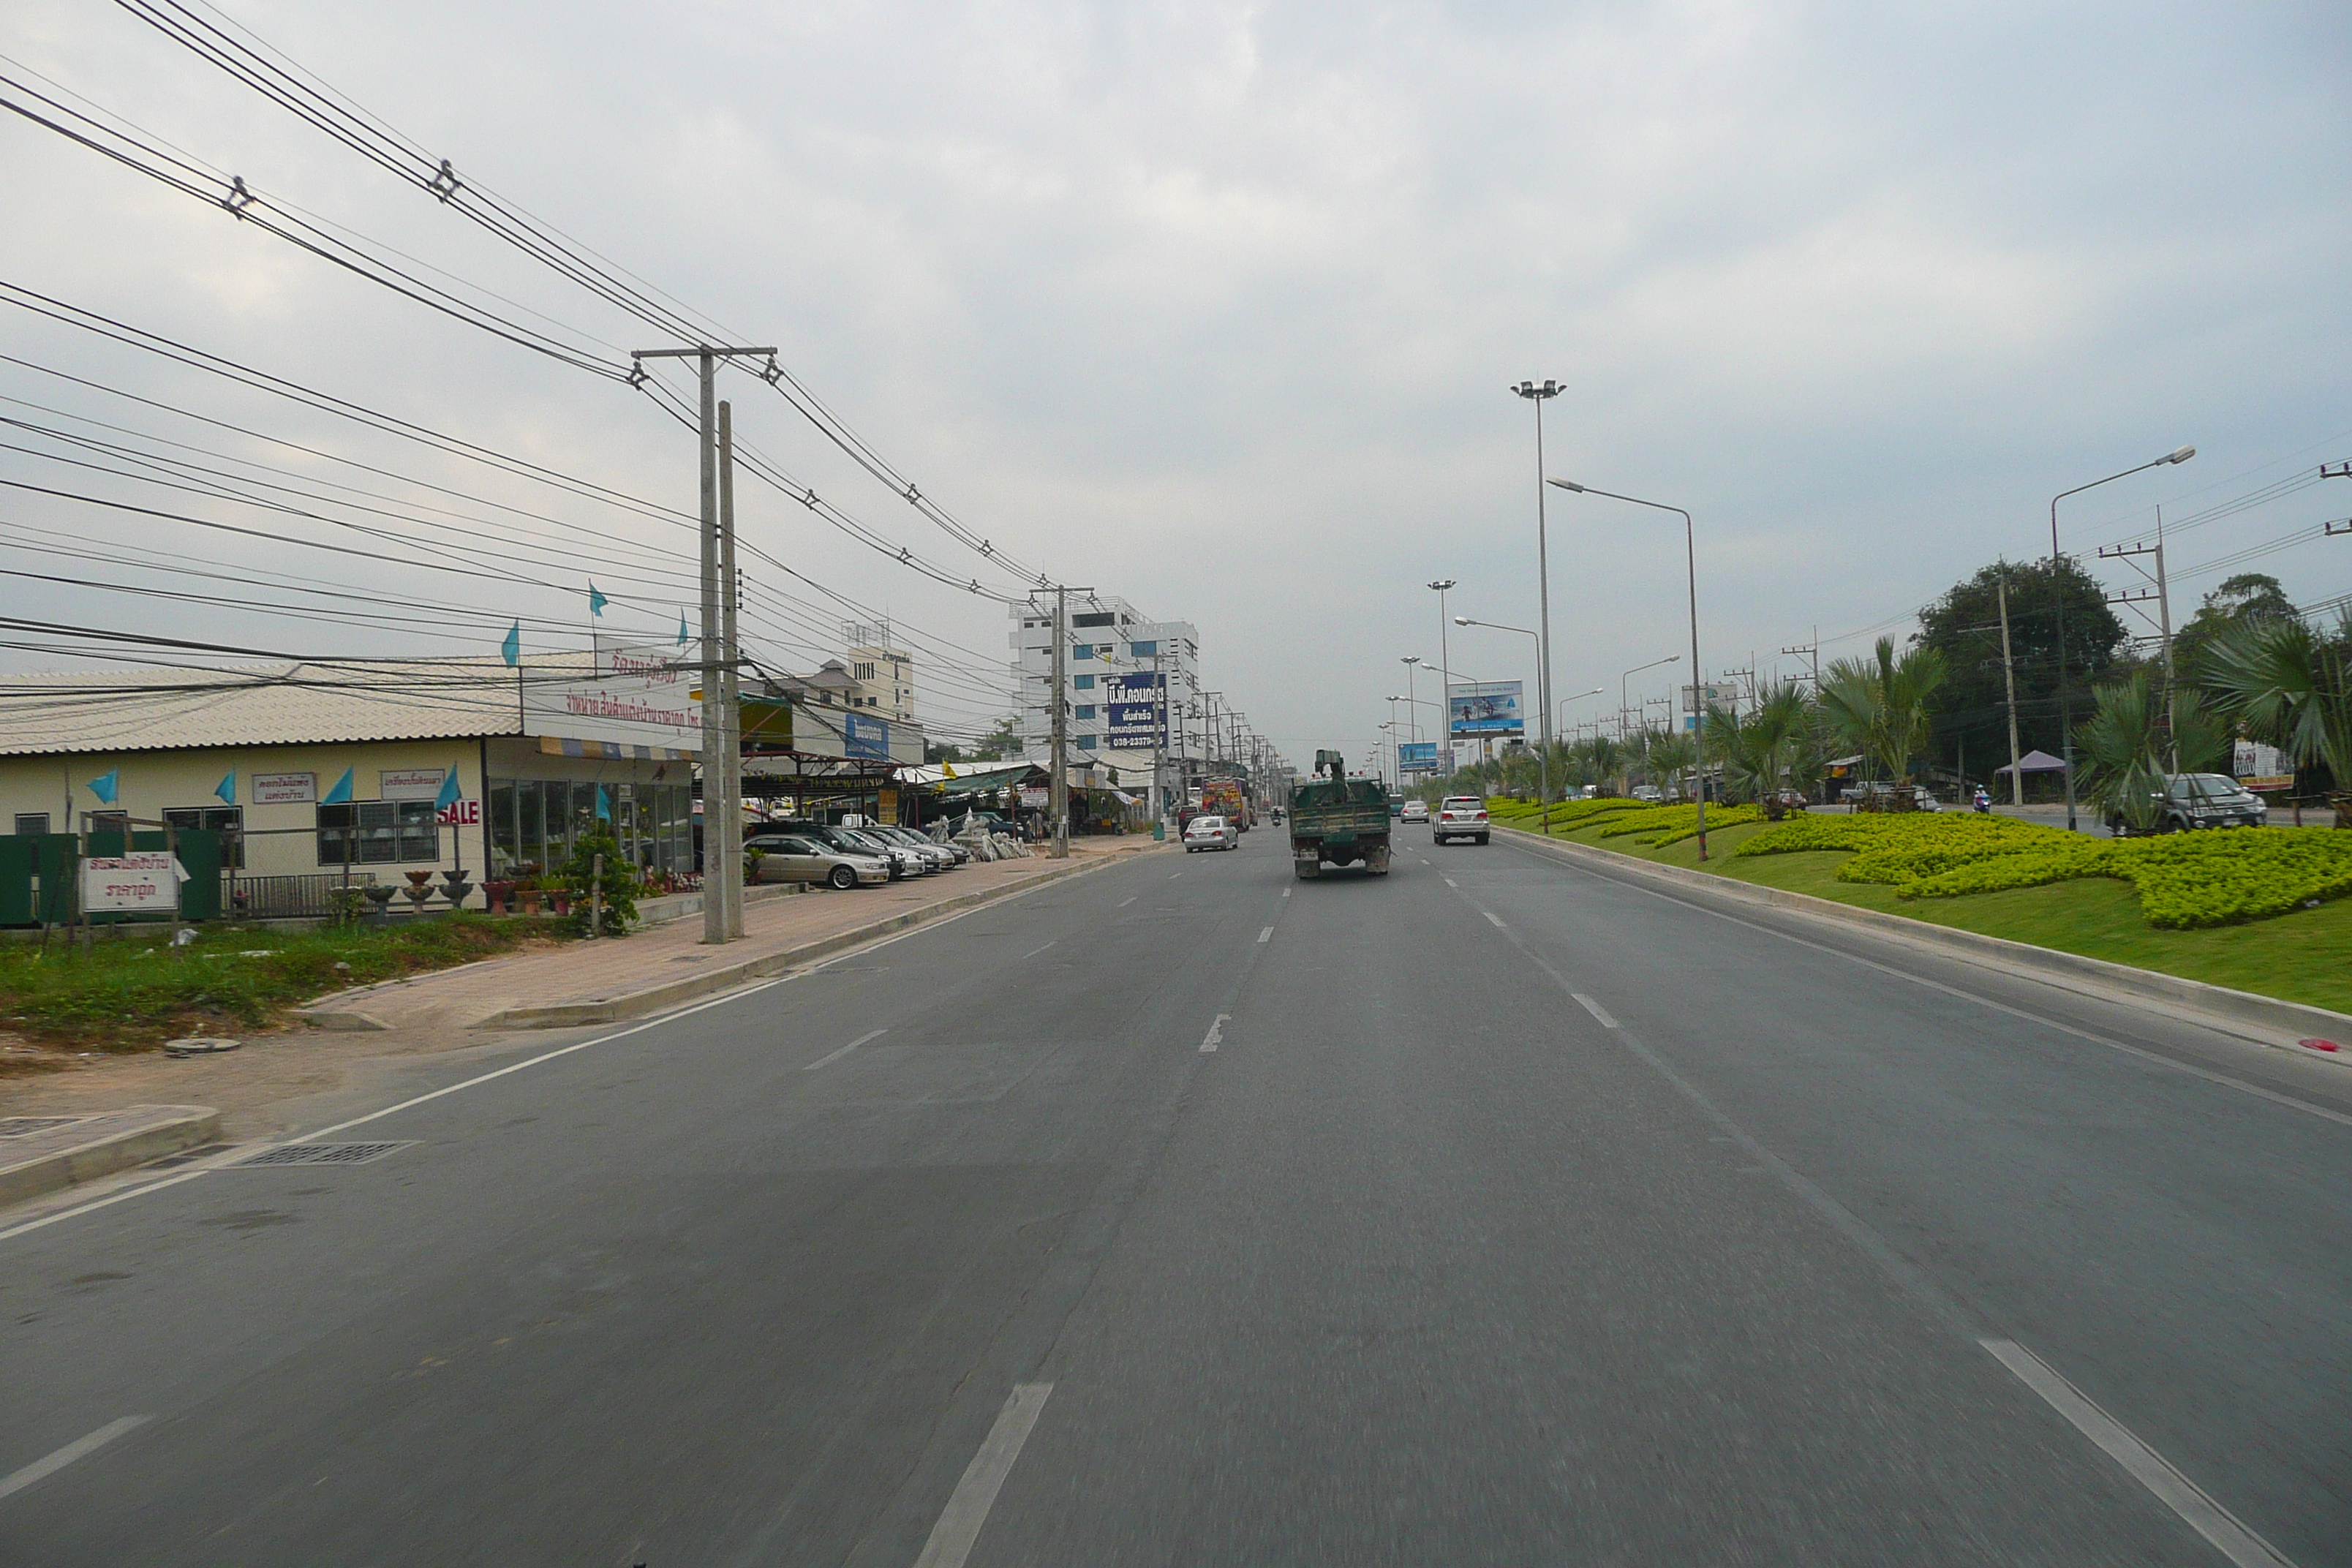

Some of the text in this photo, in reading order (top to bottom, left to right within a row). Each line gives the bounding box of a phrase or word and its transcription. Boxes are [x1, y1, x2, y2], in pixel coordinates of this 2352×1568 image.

[1109, 684, 1164, 704] บี.พี.คอนกรต
[437, 801, 478, 824] SALE
